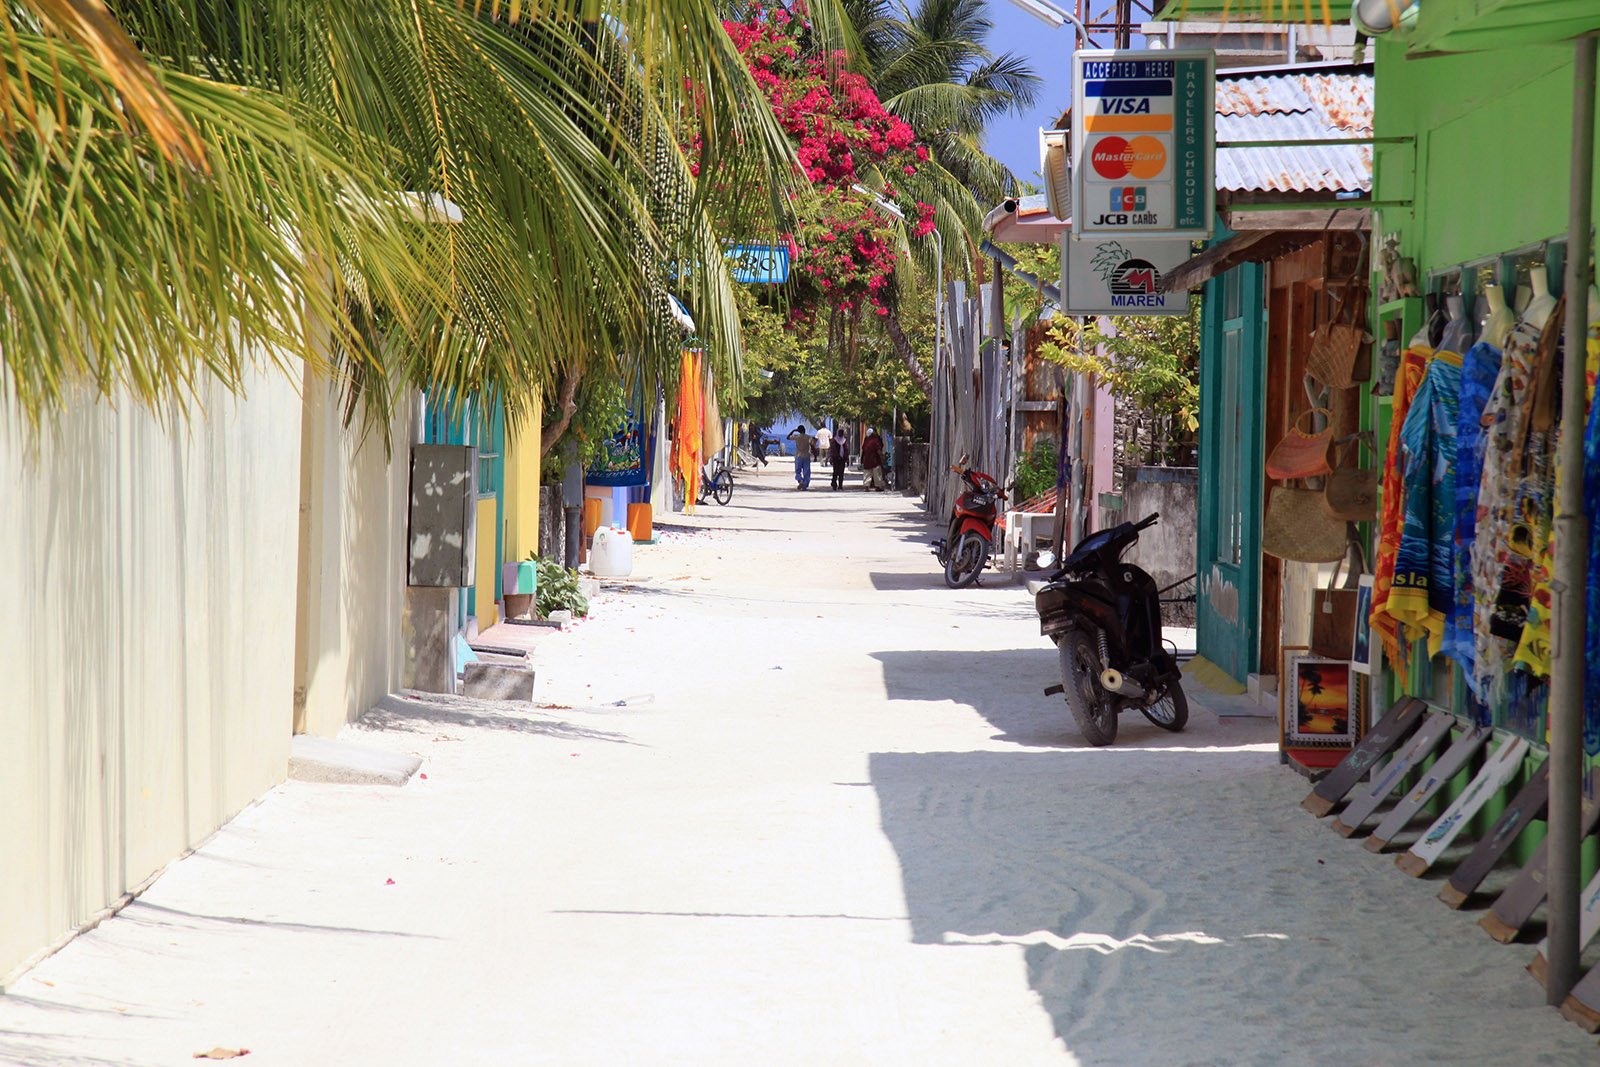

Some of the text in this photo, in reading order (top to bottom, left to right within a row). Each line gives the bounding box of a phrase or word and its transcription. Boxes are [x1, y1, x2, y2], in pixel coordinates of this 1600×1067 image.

[1085, 62, 1174, 78] ACCEPTED HERE!
[1101, 98, 1150, 114] VISA
[1185, 62, 1195, 214] TRAVELERS CHEQUES
[1094, 152, 1164, 162] MasterCard
[1111, 195, 1145, 204] JCB
[1093, 213, 1158, 225] JCB CARDS
[1111, 295, 1165, 307] MIAREN
